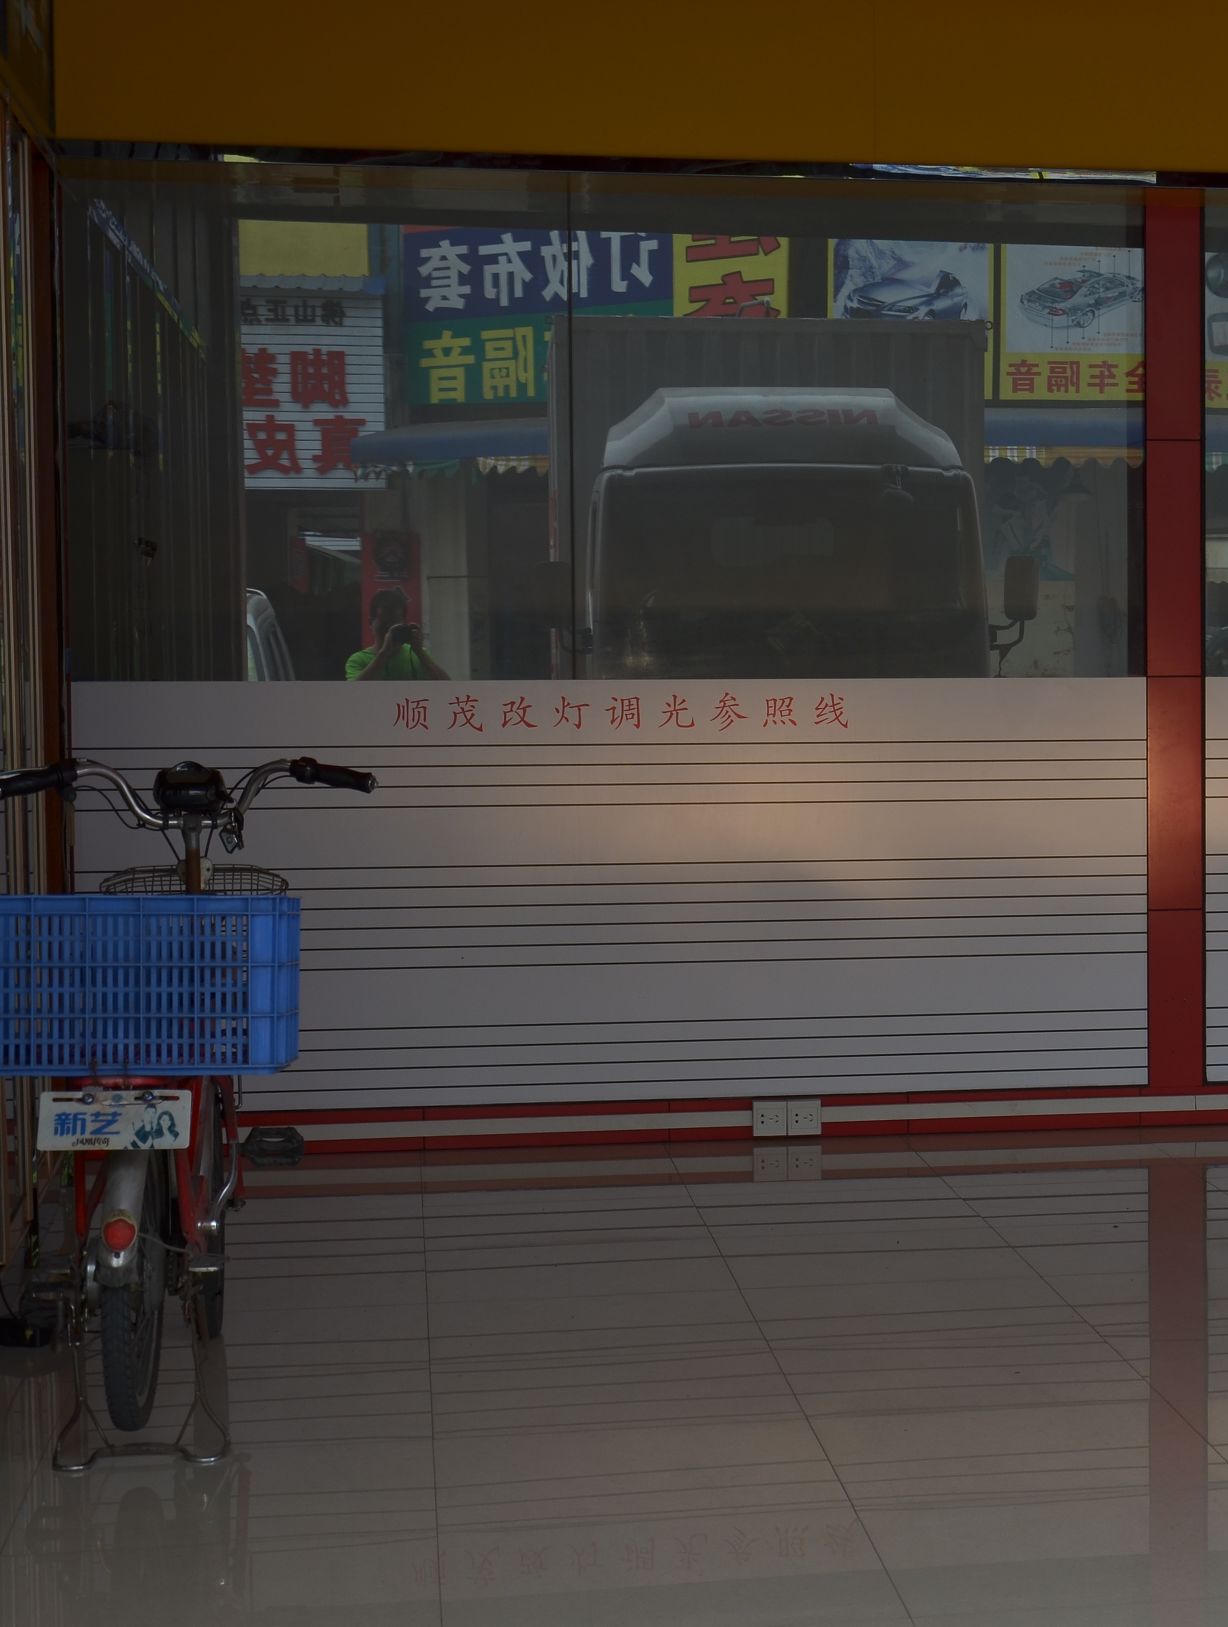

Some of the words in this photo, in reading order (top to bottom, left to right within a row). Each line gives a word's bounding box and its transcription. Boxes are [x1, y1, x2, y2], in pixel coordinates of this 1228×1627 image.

[393, 691, 850, 733] 顺茂改灯调光参照线
[53, 1110, 122, 1137] 新艺
